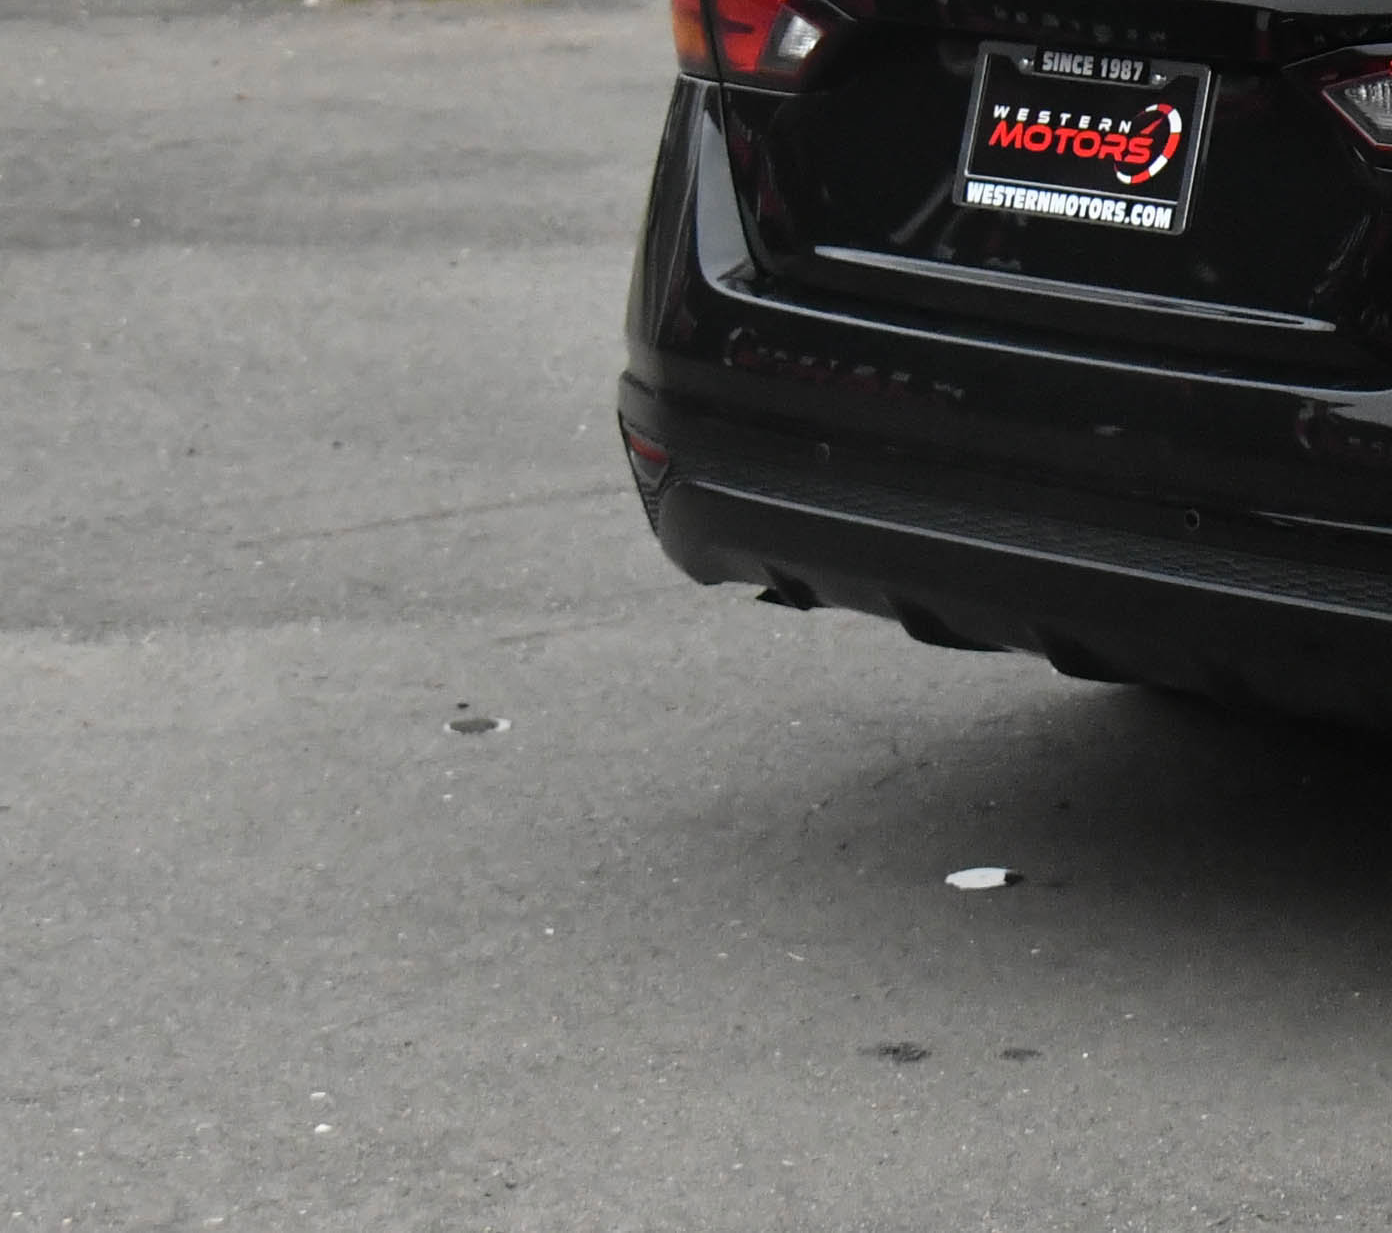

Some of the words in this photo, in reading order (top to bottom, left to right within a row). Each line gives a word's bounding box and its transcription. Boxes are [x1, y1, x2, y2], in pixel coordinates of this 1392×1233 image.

[1042, 51, 1094, 76] SINCE
[1100, 58, 1144, 81] 1987
[993, 104, 1132, 134] WESTERN
[988, 120, 1154, 164] MOTORS
[966, 180, 1173, 230] WESTERNMOTORS.COM
